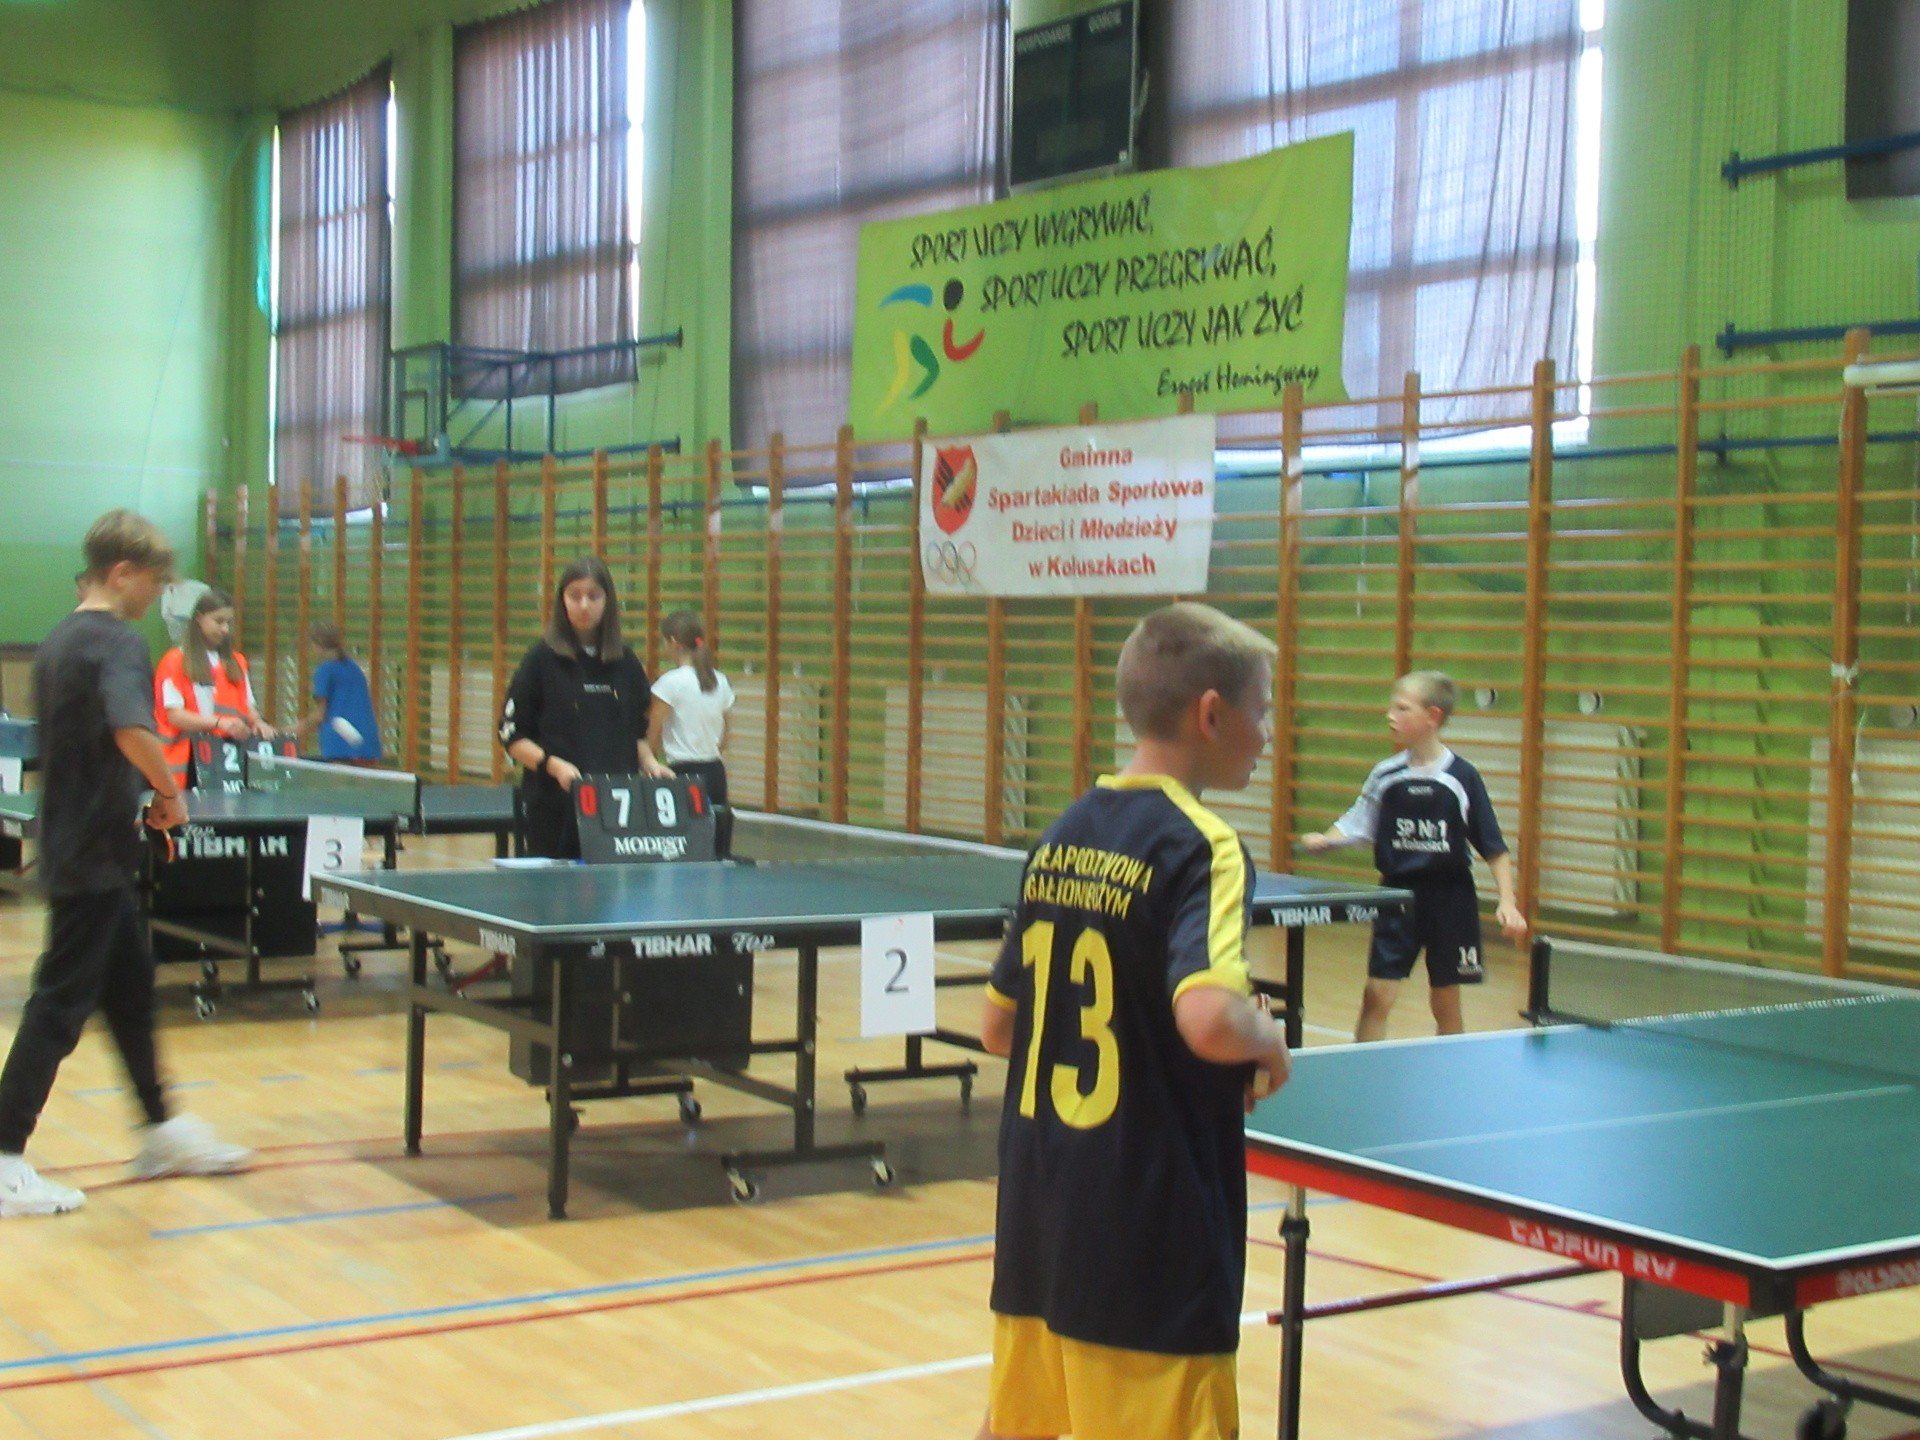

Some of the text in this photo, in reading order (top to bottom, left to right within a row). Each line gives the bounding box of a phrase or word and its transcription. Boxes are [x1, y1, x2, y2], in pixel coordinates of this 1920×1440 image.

[910, 228, 967, 269] SPORT
[973, 218, 1028, 257] UCZY
[980, 269, 1046, 312] SPORT
[1051, 260, 1109, 300] UCZY
[1062, 284, 1303, 359] SPORT UCZY JAK ŻYĆ
[1060, 445, 1133, 469] Gminna
[988, 477, 1203, 513] Spartakiada Sportowa
[1012, 518, 1065, 542] Dzieci
[1080, 514, 1177, 544] Młodzieży
[1028, 553, 1156, 578] w Koluszkach
[222, 742, 241, 773] 2
[611, 788, 630, 828] 7
[655, 787, 677, 828] 9
[688, 785, 703, 814] 1
[322, 838, 343, 870] 3
[631, 933, 713, 959] TIBHAR
[1458, 946, 1478, 966] 14
[884, 947, 909, 994] 2
[1020, 919, 1120, 1130] 13
